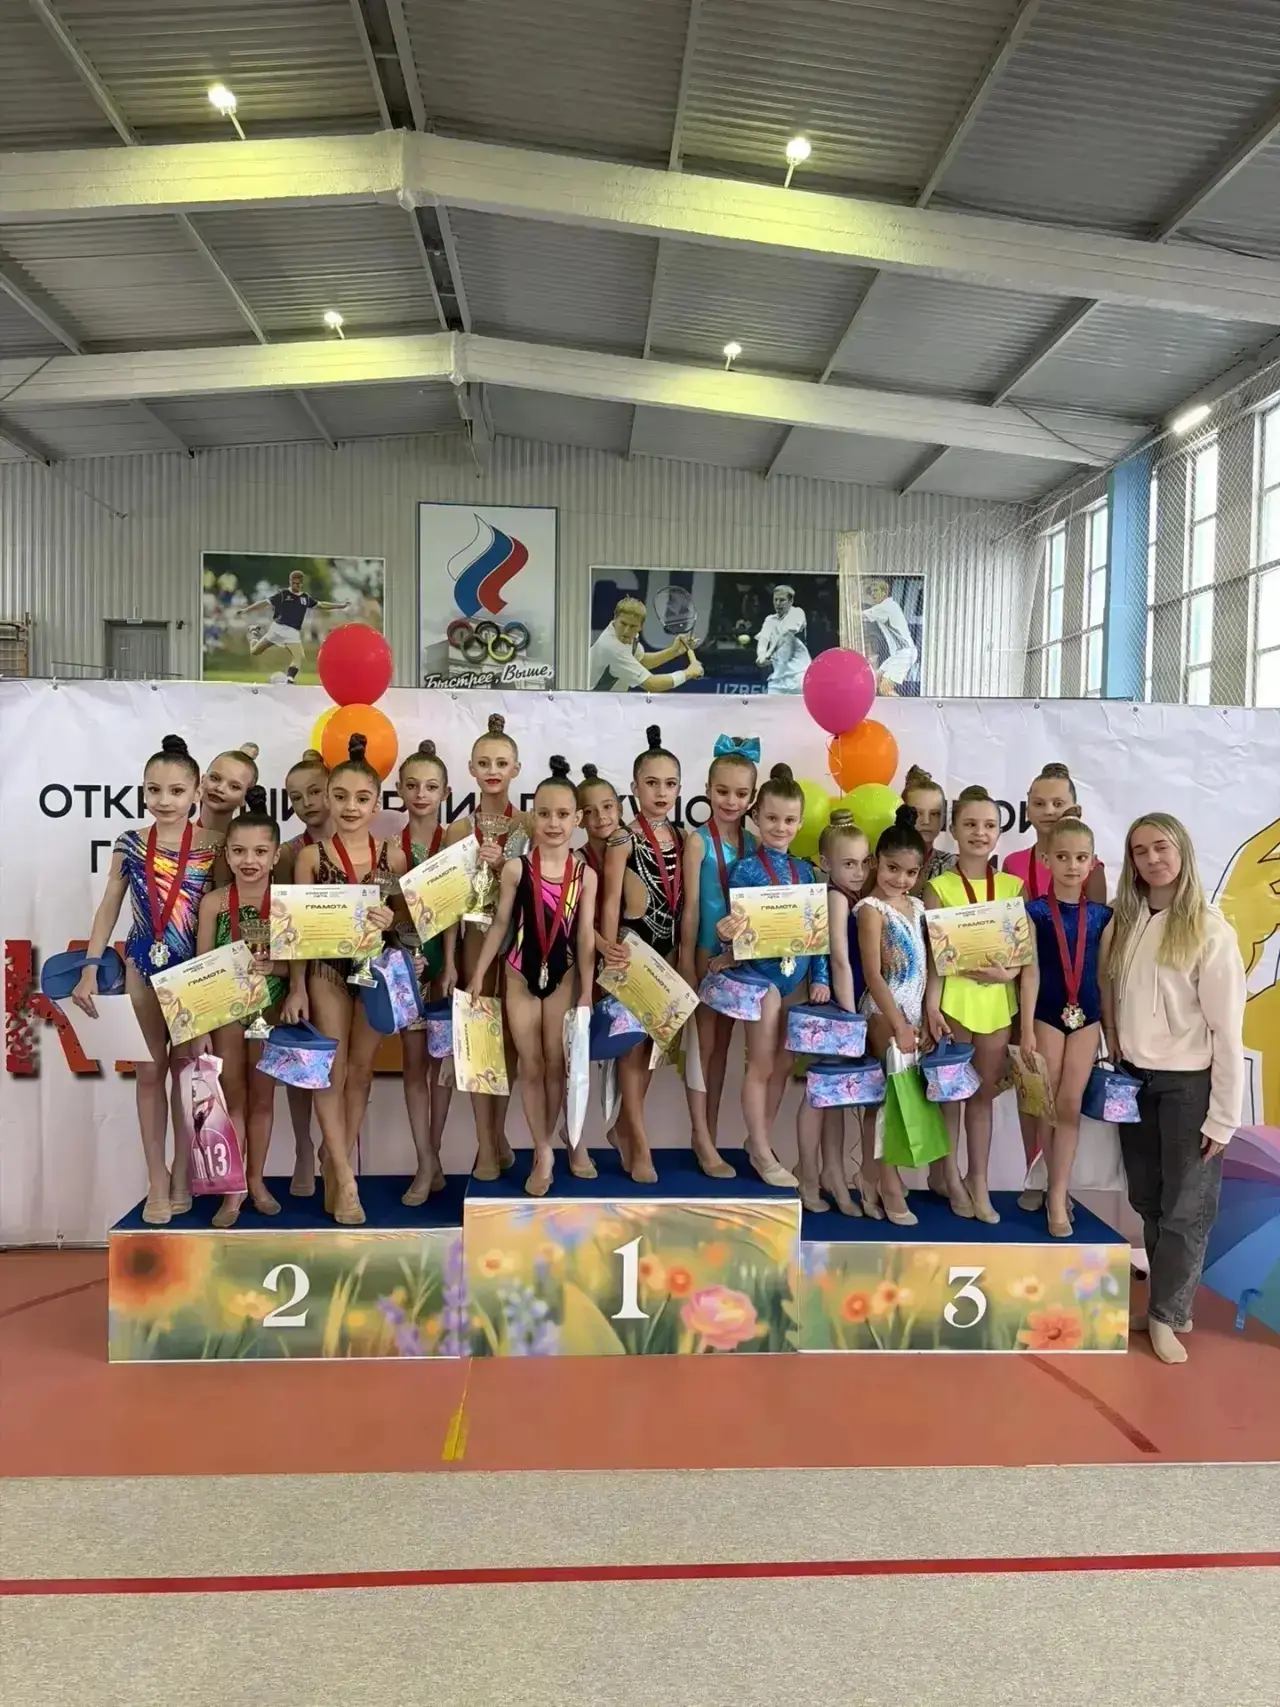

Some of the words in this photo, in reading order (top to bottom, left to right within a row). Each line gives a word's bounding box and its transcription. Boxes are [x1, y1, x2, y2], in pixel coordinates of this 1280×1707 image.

[503, 664, 553, 681] Выше,
[427, 865, 458, 886] ГРАМОТА
[957, 919, 996, 929] ГРАМОТА
[187, 968, 227, 987] ГРАМОТА
[643, 964, 671, 994] ГРАМОТА
[611, 1235, 651, 1321] 1
[262, 1263, 311, 1328] 2
[943, 1266, 987, 1328] 3
